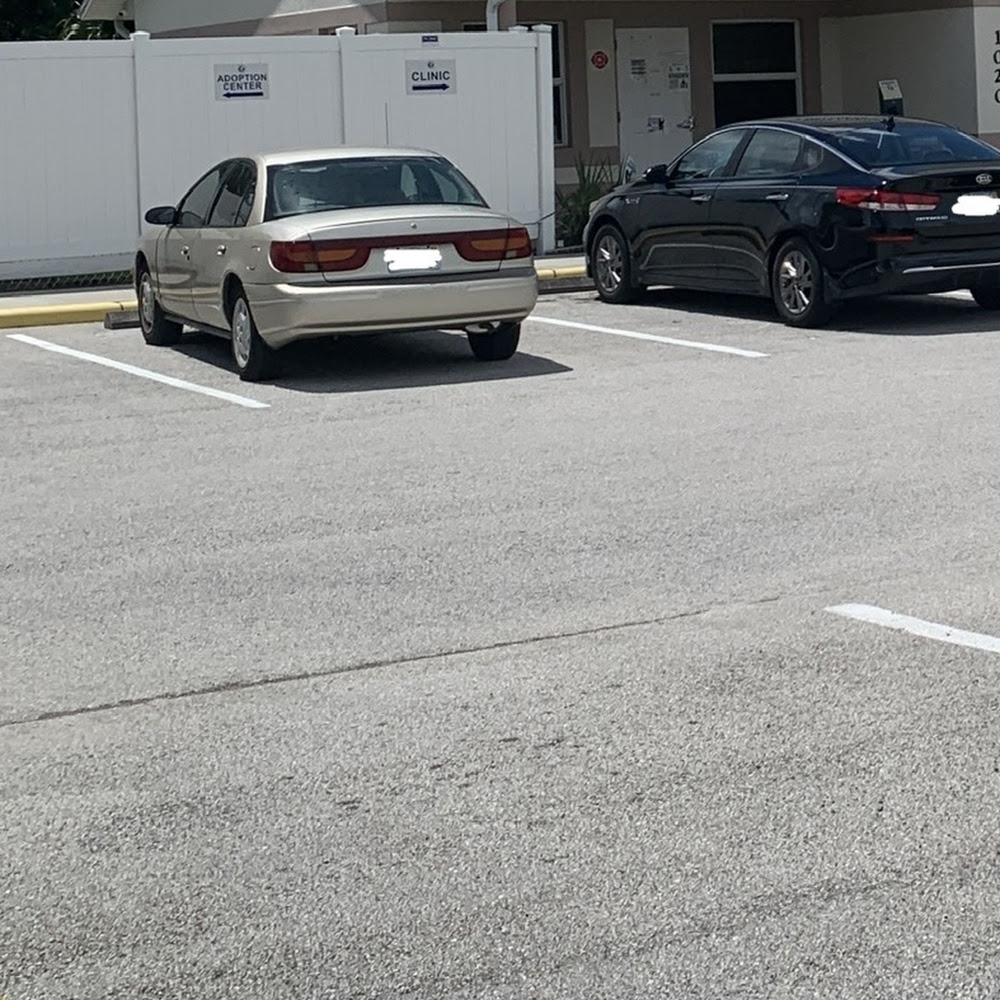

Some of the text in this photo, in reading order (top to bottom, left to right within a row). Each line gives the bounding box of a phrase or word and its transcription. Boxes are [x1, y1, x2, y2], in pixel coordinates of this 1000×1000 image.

[217, 73, 267, 83] ADOPTION
[411, 70, 451, 82] CLINIC
[223, 81, 262, 91] CENTER
